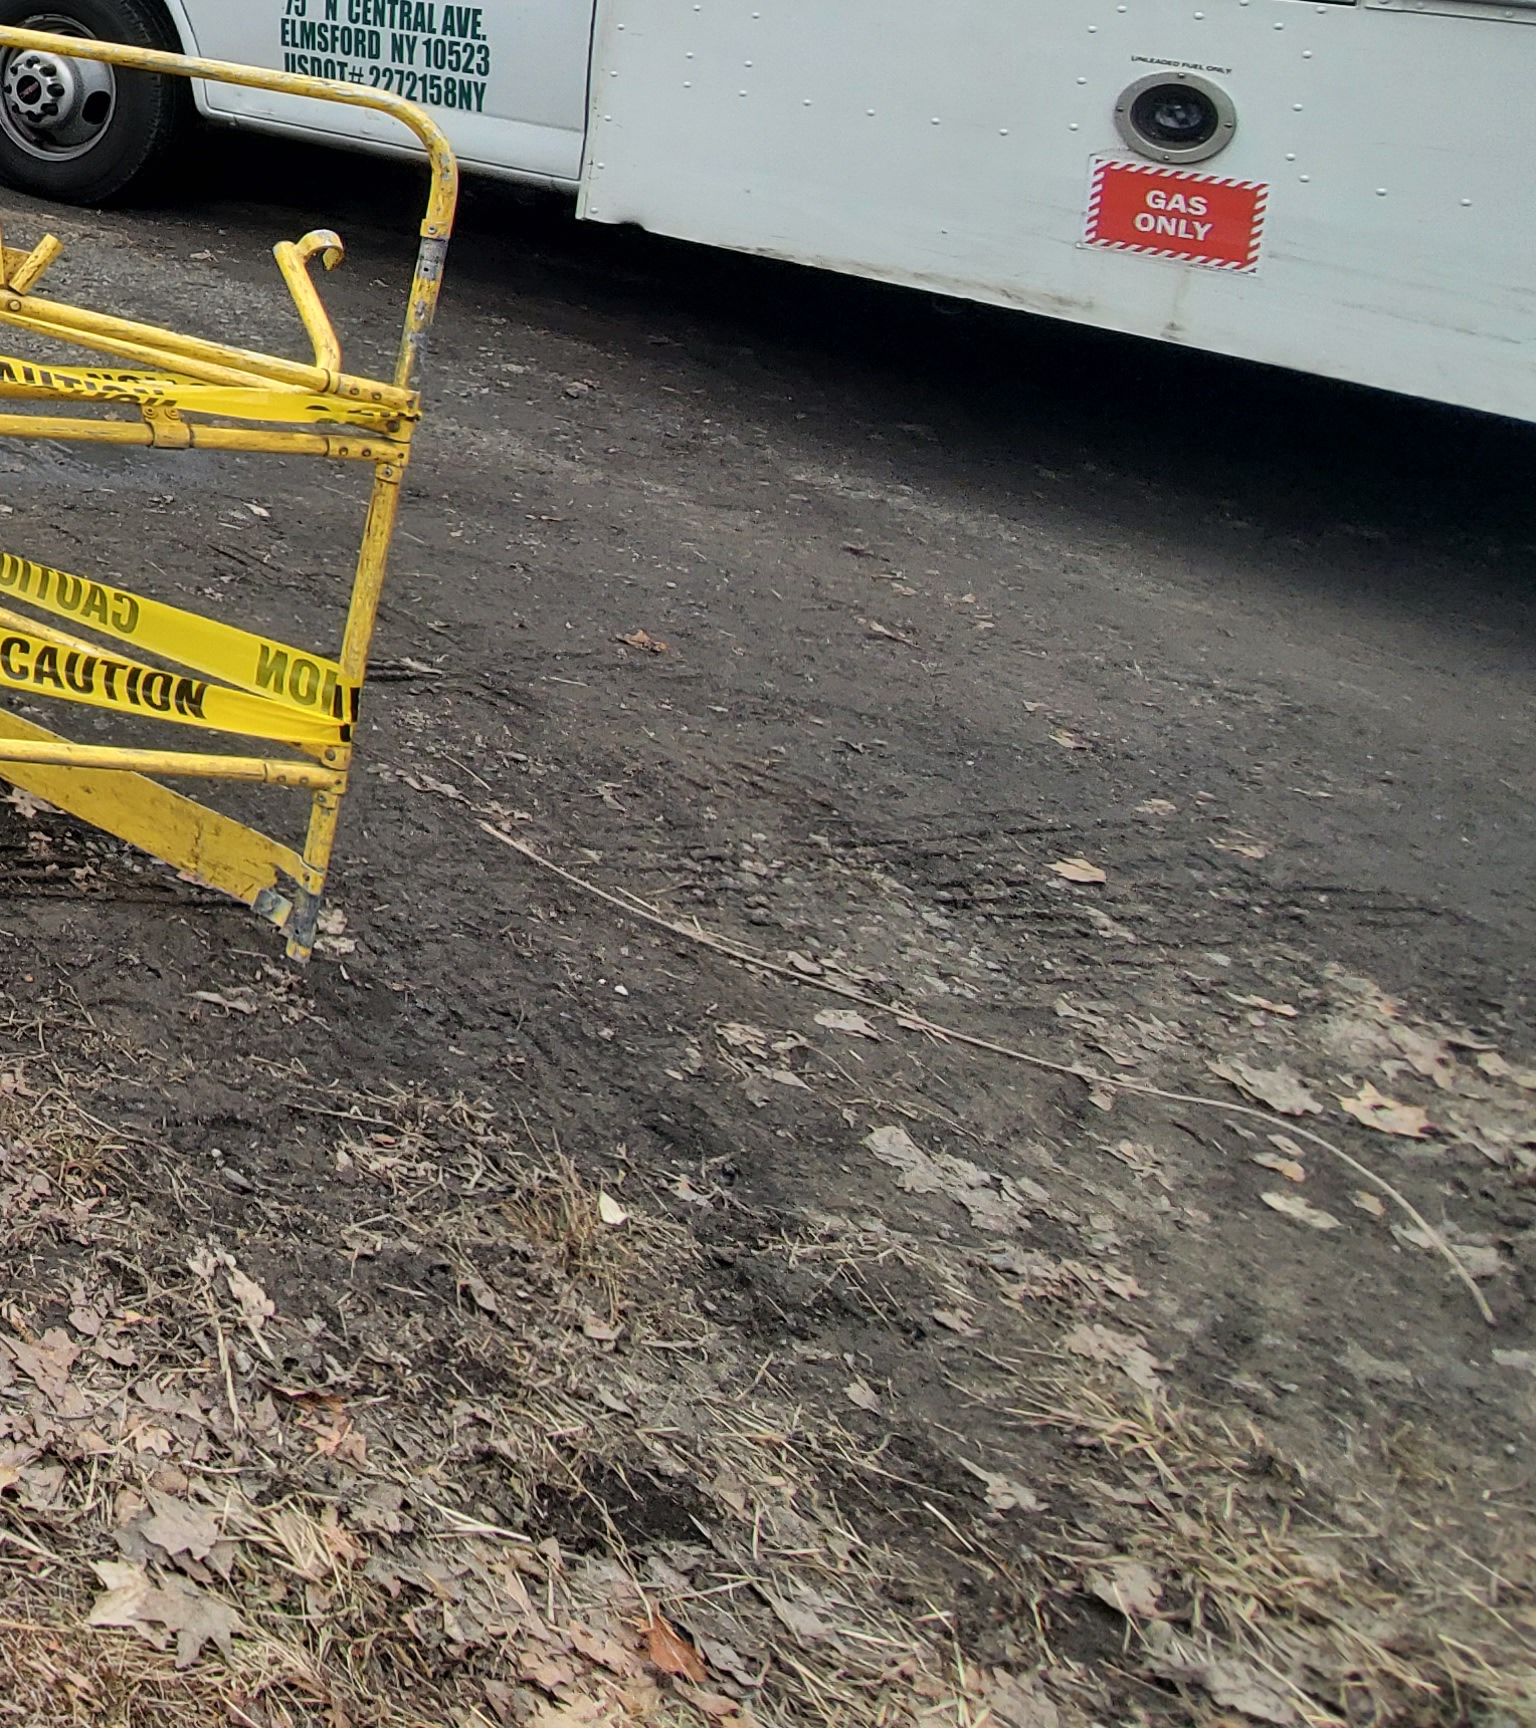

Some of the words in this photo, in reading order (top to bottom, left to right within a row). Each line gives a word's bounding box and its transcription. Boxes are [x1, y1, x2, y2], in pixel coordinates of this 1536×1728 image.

[441, 4, 487, 41] AVE.
[281, 18, 381, 60] ELMSFORD
[391, 32, 418, 65] NY
[422, 37, 490, 76] 10523
[1131, 55, 1180, 68] UNLEADED
[1181, 62, 1203, 71] FUEL
[1206, 65, 1232, 74] ONLY
[369, 65, 487, 112] 2272158NY
[1146, 189, 1208, 216] GAS
[1134, 212, 1213, 241] ONLY
[0, 637, 207, 719] CAUTION
